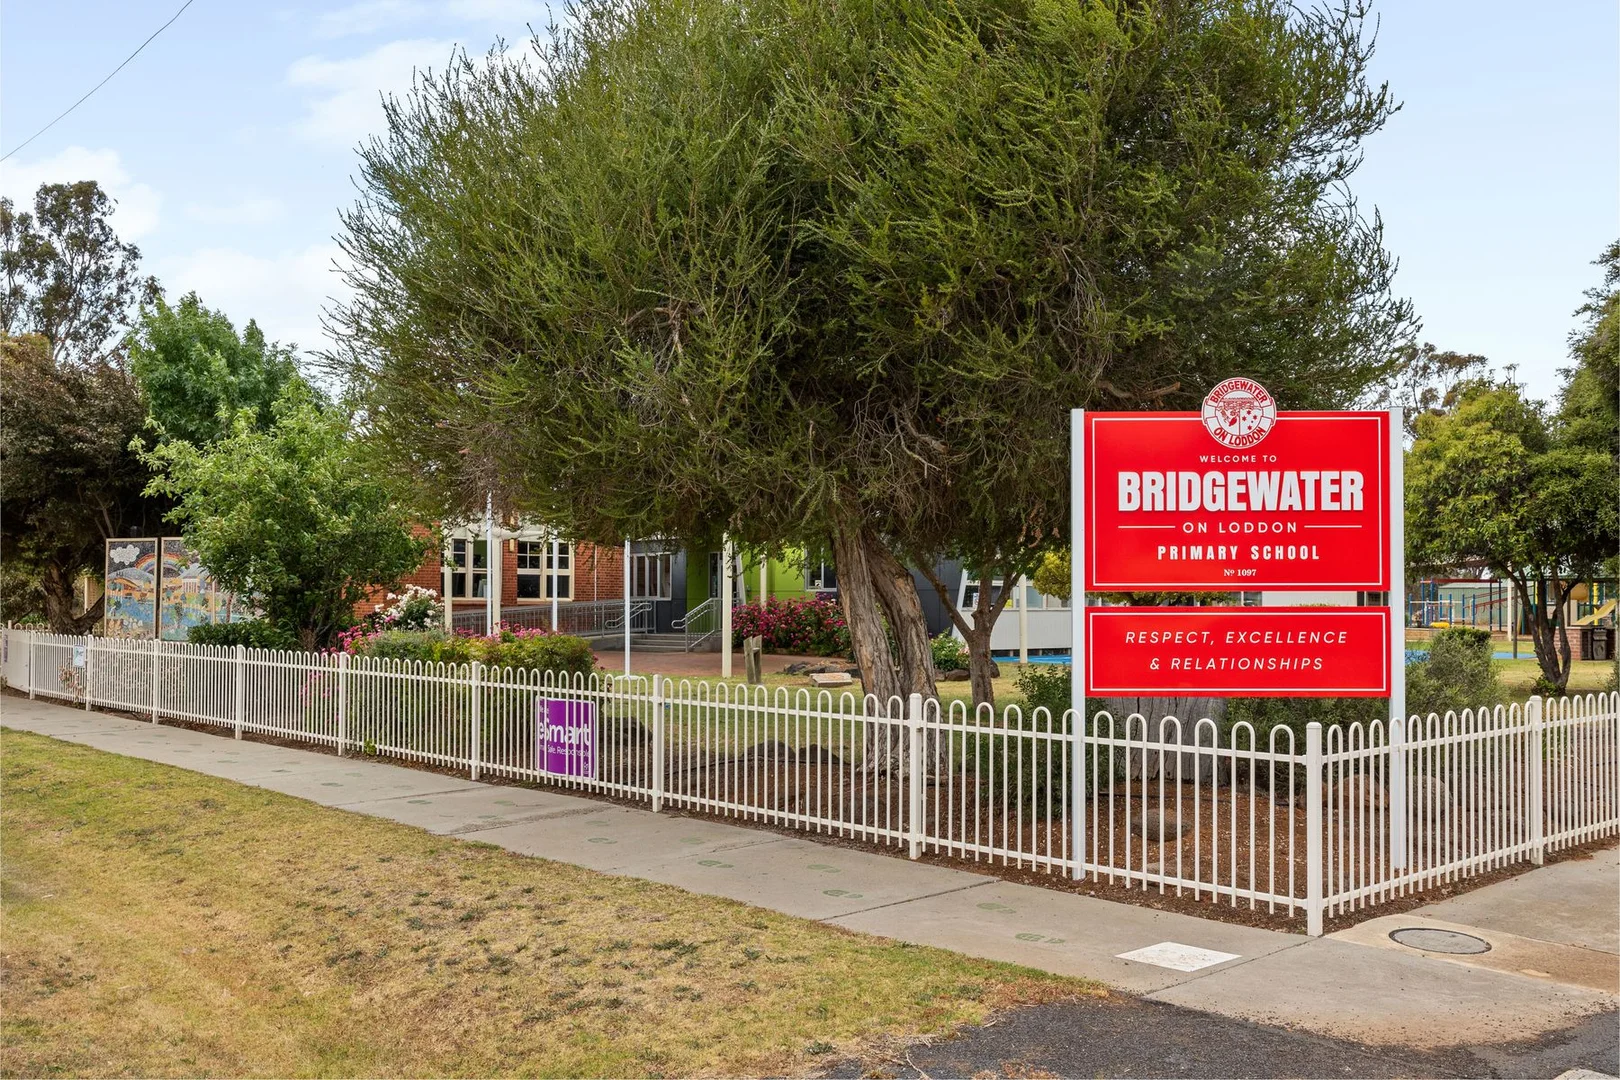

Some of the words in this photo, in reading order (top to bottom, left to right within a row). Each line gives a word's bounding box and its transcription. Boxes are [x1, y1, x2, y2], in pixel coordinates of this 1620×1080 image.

[1210, 381, 1268, 403] BRIDGEWATER
[1213, 427, 1228, 442] ON
[1228, 426, 1267, 446] LODDON
[1199, 454, 1257, 463] WELCOME
[1262, 454, 1278, 463] TO
[1117, 470, 1365, 512] BRIDGEWATER
[1182, 521, 1208, 534] ON
[1218, 521, 1298, 534] LODDON
[1157, 545, 1239, 561] PRIMARY
[1250, 545, 1320, 561] SCHOOL
[1237, 568, 1257, 577] 1097
[1125, 630, 1216, 646] RESPECT,
[1225, 630, 1348, 644] EXCELLENCE
[1149, 657, 1161, 670] &
[1170, 657, 1323, 671] RELATIONSHIPS
